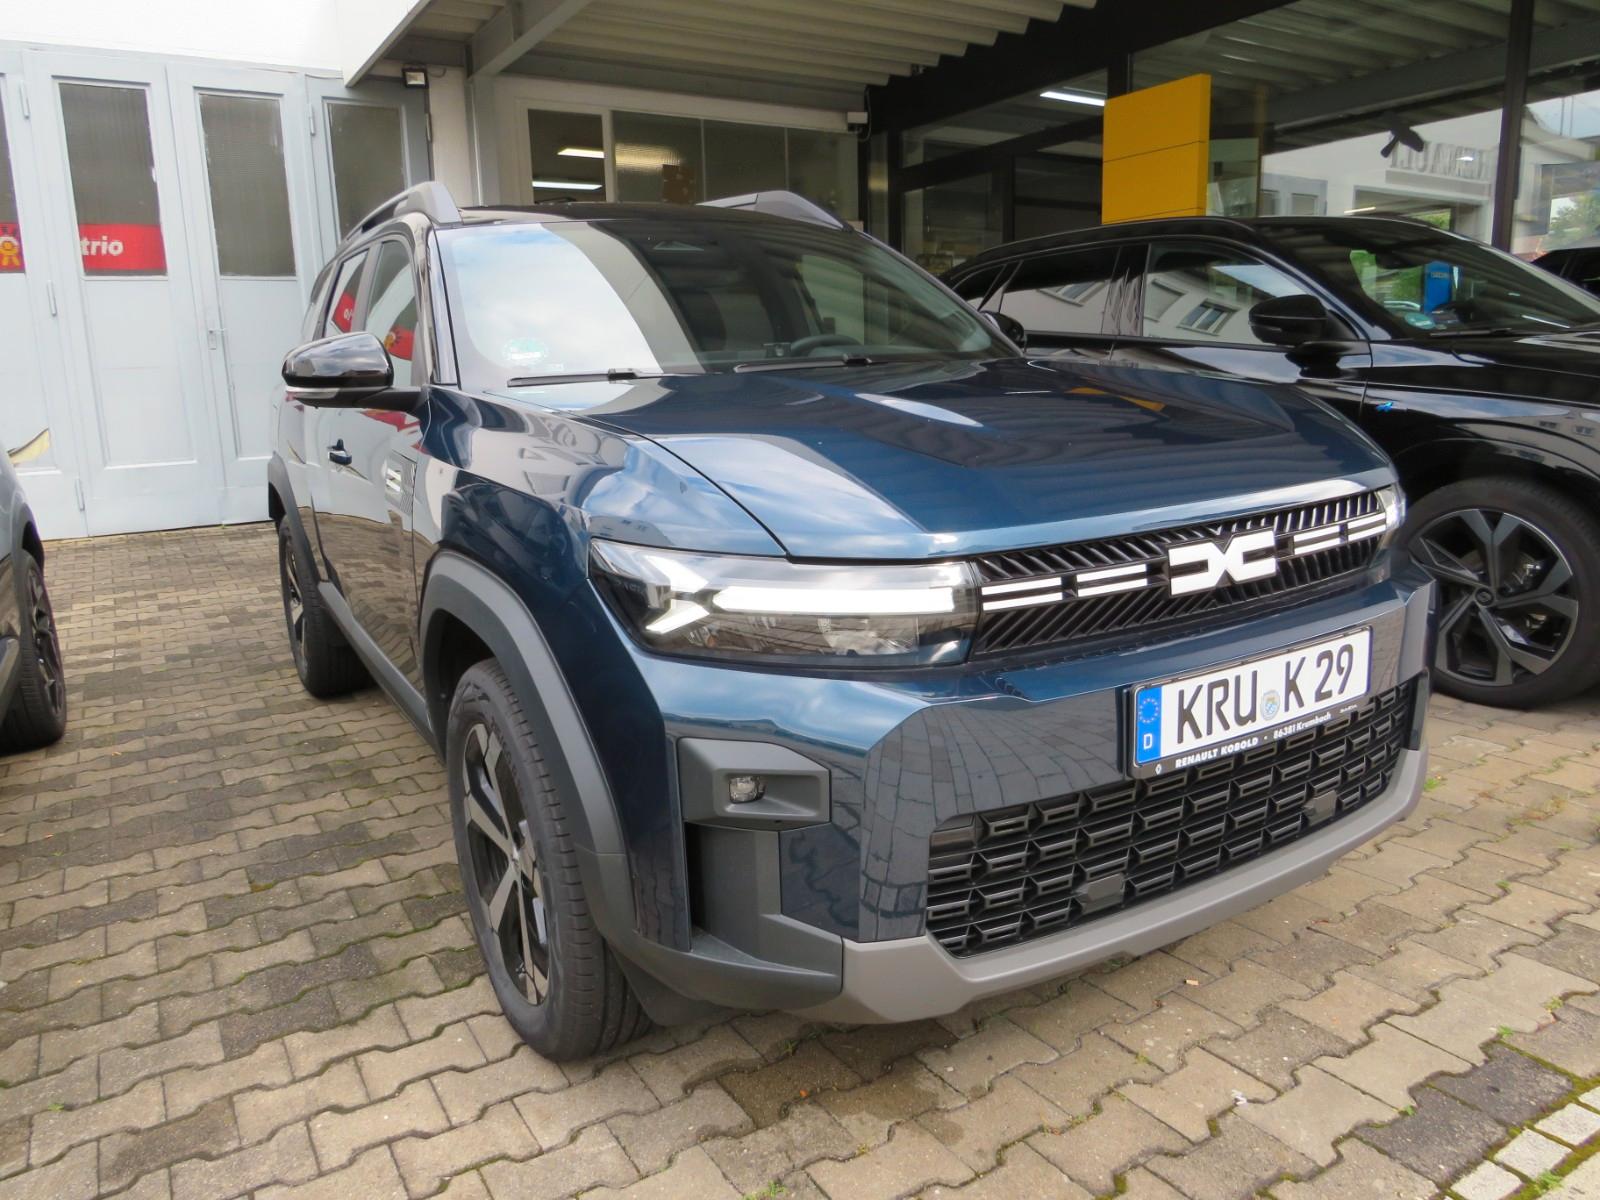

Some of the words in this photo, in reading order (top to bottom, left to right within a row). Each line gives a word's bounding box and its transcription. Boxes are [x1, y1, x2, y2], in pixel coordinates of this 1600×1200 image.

[1177, 670, 1258, 744] KRU
[1284, 656, 1306, 712] K
[1315, 644, 1354, 702] 29
[1143, 733, 1153, 749] D
[1175, 748, 1218, 768] RENAULT
[1220, 737, 1258, 755] KOBOLD
